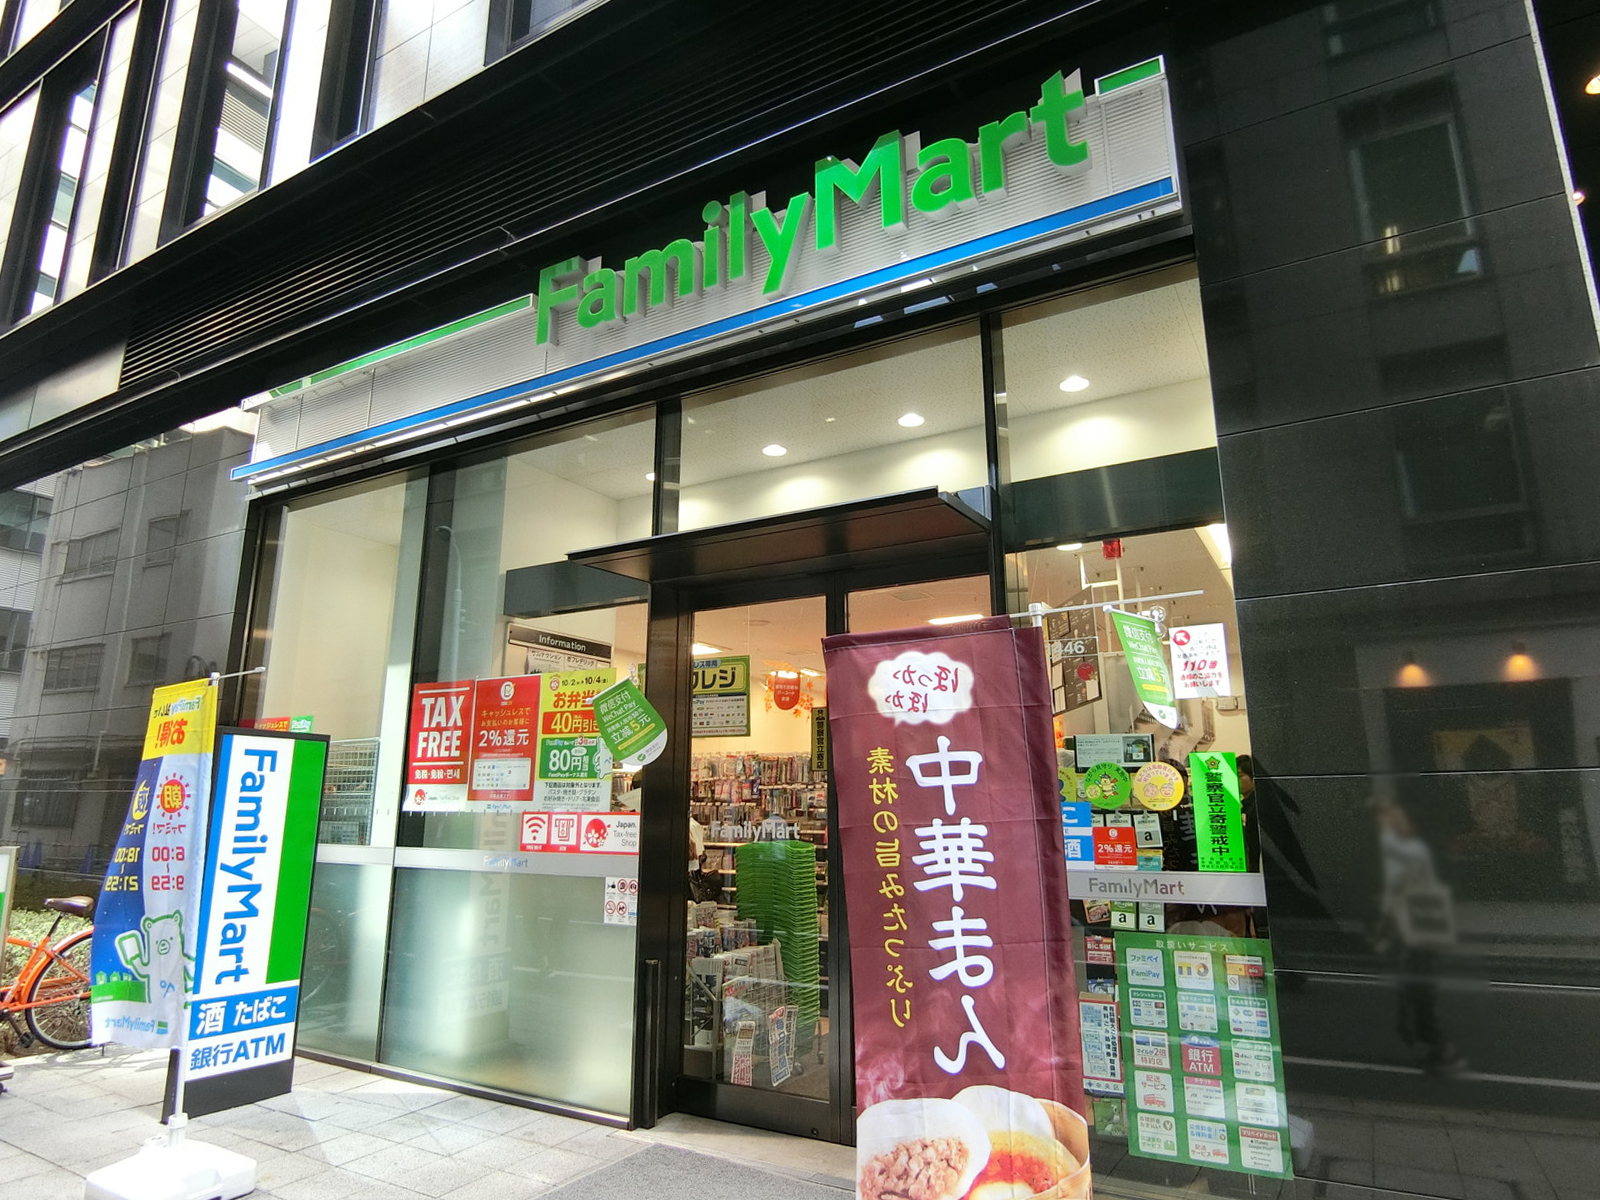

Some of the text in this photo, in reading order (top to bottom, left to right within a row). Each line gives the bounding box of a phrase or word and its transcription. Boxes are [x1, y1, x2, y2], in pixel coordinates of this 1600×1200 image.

[536, 70, 1092, 347] FamilyMart
[539, 634, 586, 652] Information
[422, 695, 465, 728] TAX
[481, 707, 531, 717] キャッシュレスで
[417, 730, 462, 758] FREE
[478, 728, 530, 747] 2%還元
[711, 821, 800, 843] FamilyMart
[621, 839, 637, 847] Shop
[215, 748, 278, 985] FamilyMart
[1088, 877, 1185, 898] FamilyMart
[1118, 912, 1127, 923] a
[1147, 914, 1156, 926] a
[1156, 940, 1228, 952] 取扱いサービス
[1131, 969, 1160, 978] FamiPay
[196, 995, 287, 1035] 酒 たばこ
[190, 1033, 286, 1071] 銀行ATM
[1188, 1048, 1214, 1062] 銀行
[1141, 1056, 1163, 1065] 特約店
[1189, 1062, 1214, 1073] ATM
[1141, 1082, 1167, 1091] サービス
